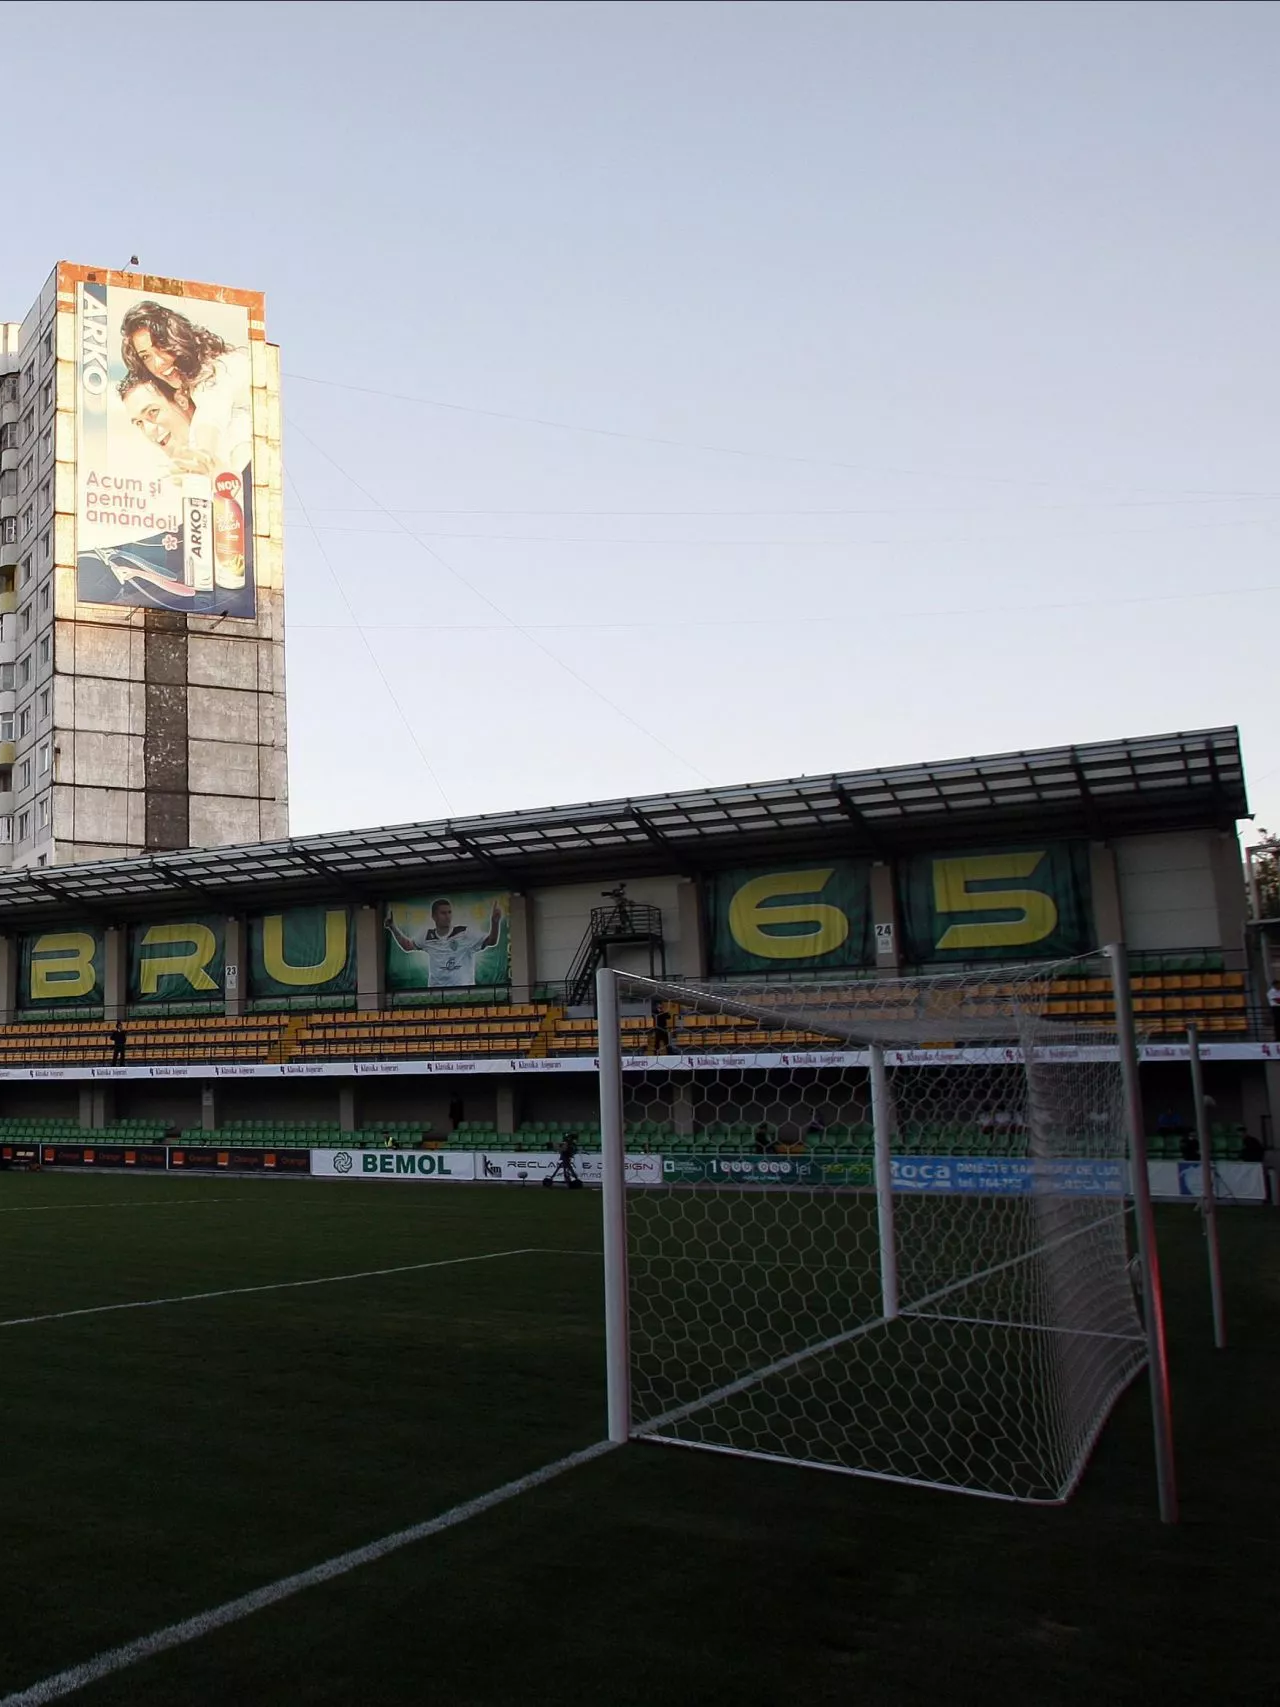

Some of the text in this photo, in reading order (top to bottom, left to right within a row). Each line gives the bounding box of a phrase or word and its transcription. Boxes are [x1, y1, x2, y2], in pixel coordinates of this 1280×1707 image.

[83, 289, 108, 396] ARKO
[87, 471, 143, 492] Acum
[217, 480, 240, 492] NOU
[87, 492, 147, 510] pentru
[87, 509, 178, 531] amândoi!
[191, 509, 202, 559] ARKO
[876, 925, 892, 936] 24
[226, 966, 237, 976] 23
[362, 1154, 452, 1175] BEMOL
[582, 1162, 593, 1170] &
[709, 1159, 718, 1174] 1
